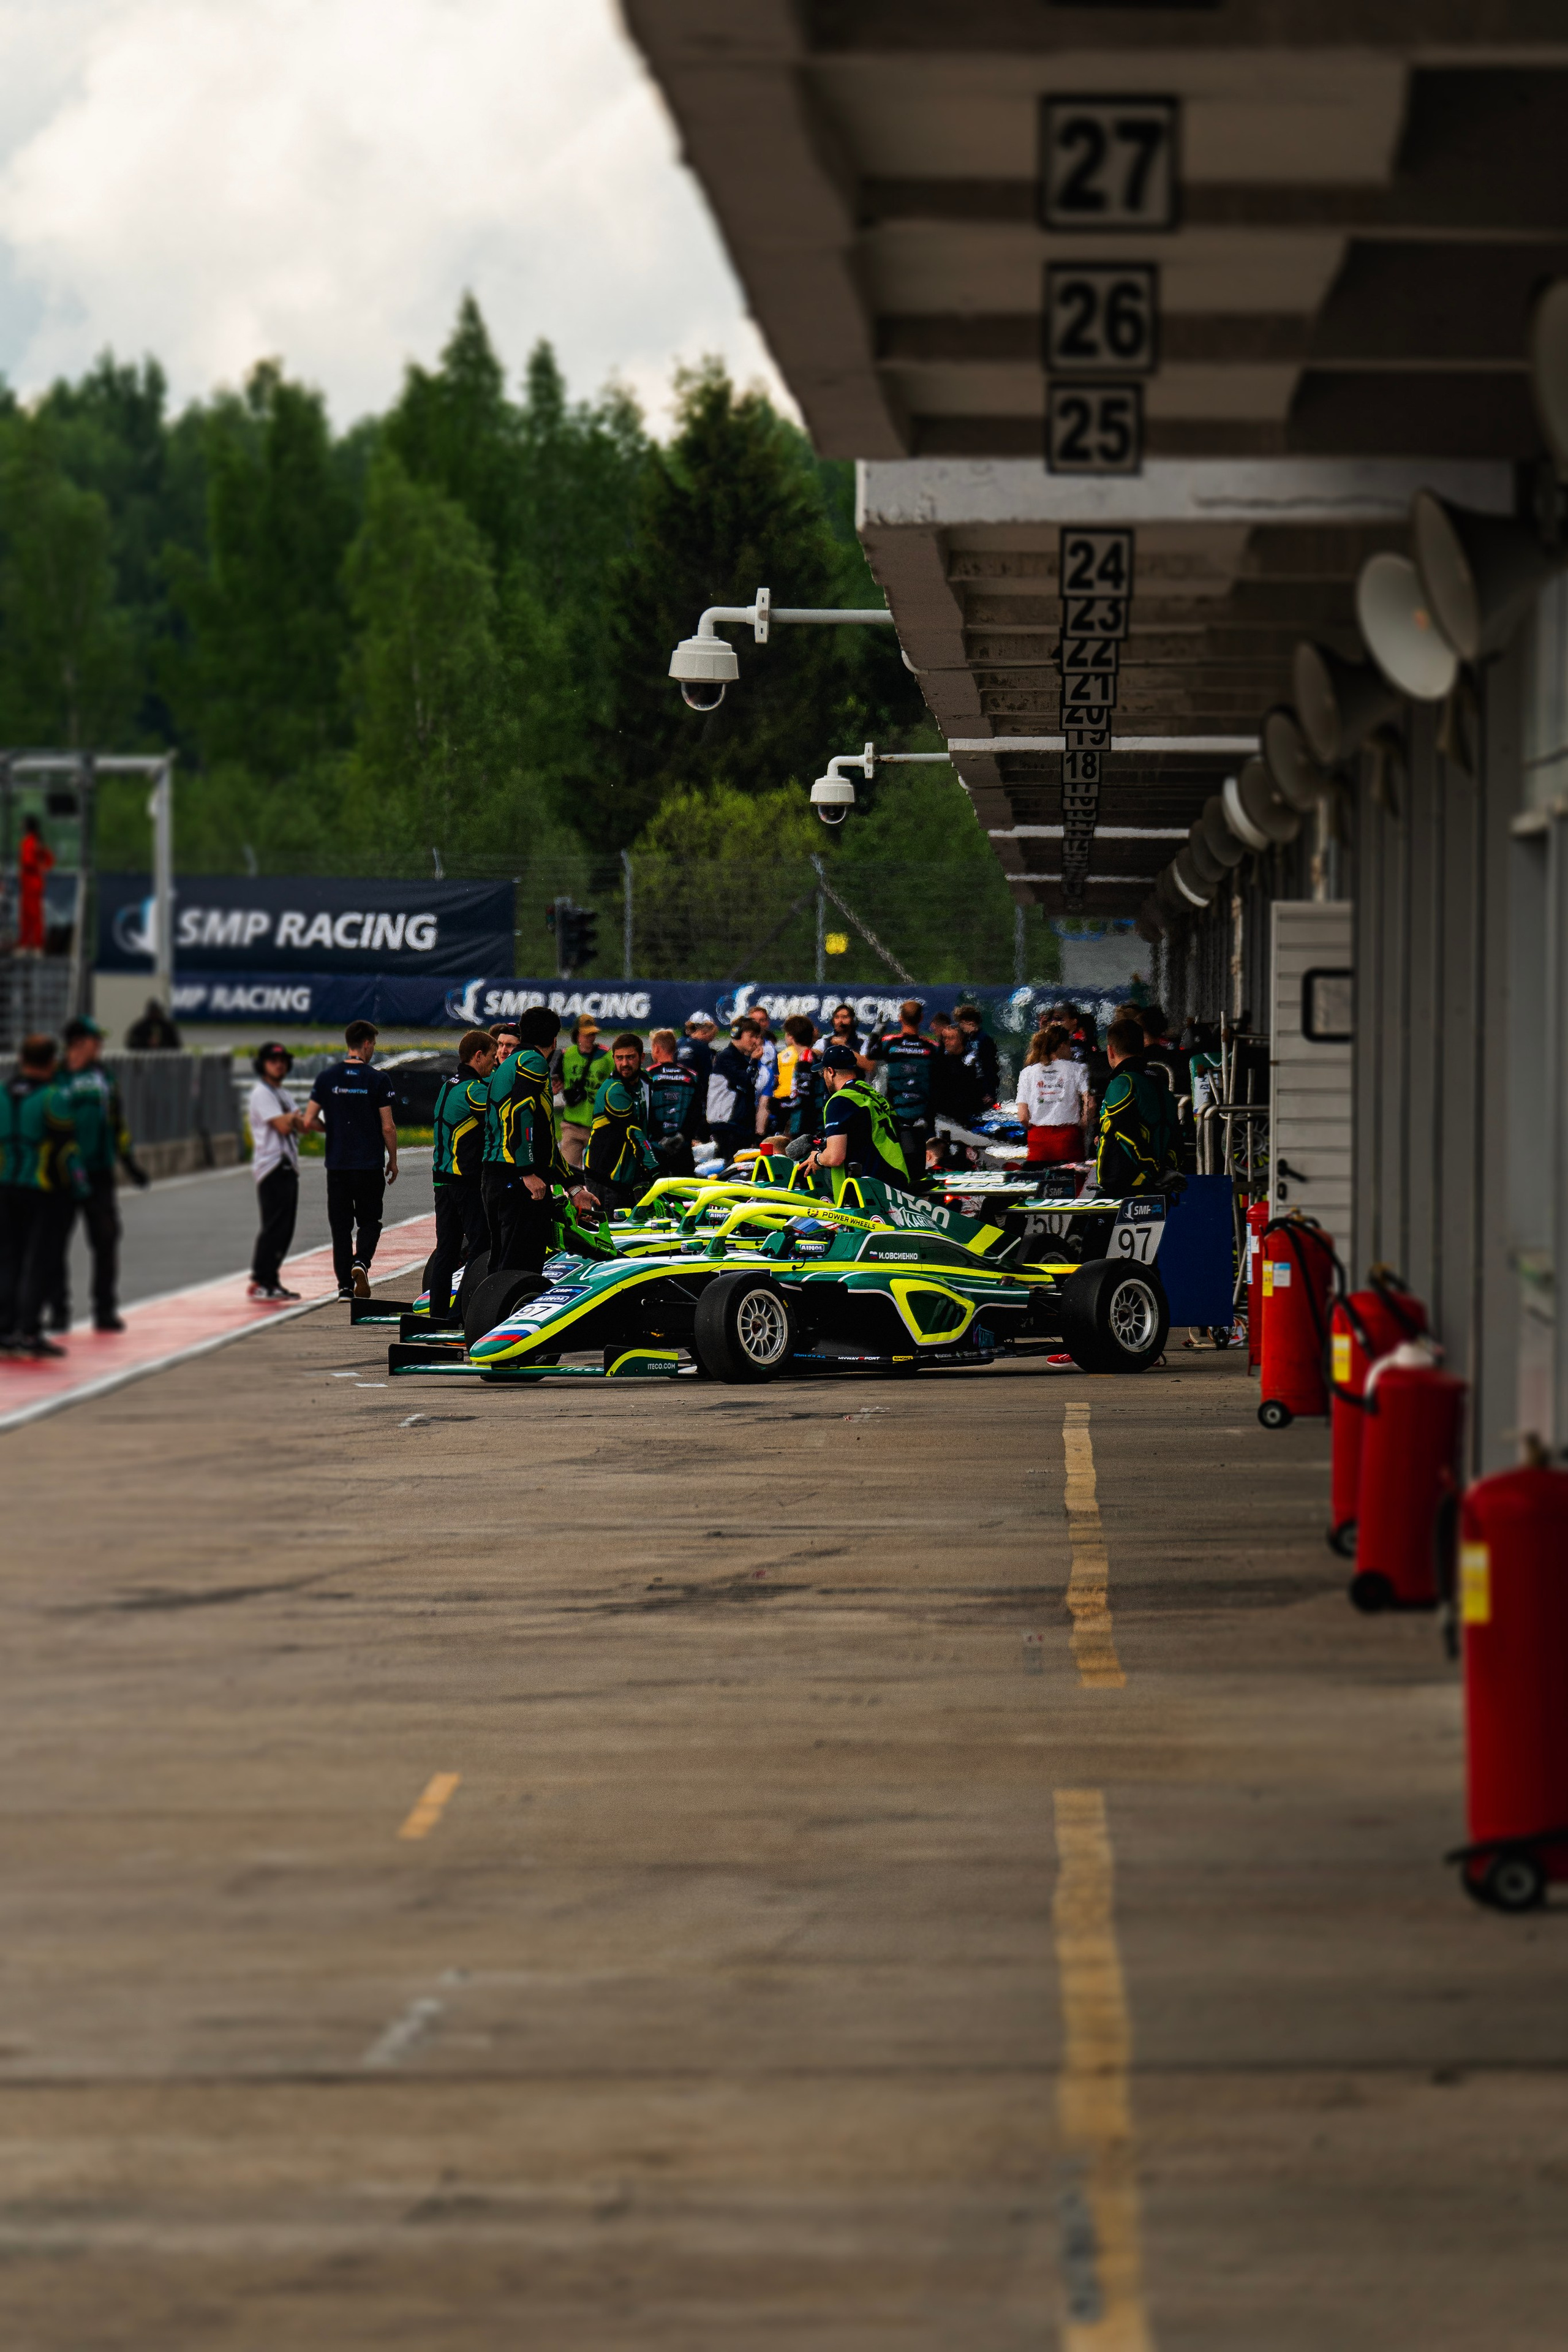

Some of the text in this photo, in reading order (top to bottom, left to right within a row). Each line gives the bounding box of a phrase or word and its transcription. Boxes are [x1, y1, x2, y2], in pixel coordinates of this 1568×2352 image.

[1056, 115, 1163, 213] 27
[1057, 279, 1147, 360] 26
[1057, 396, 1132, 462] 25
[1066, 540, 1125, 590] 24
[1069, 598, 1121, 631] 23
[1066, 641, 1113, 668] 22
[1069, 676, 1109, 700] 21
[1065, 752, 1097, 780] 18
[178, 910, 437, 951] SMP RACING
[172, 986, 312, 1012] MP RACING
[484, 989, 652, 1019] SMP RACING
[822, 1211, 850, 1222] POWER
[850, 1217, 876, 1230] WHEELS
[1118, 1227, 1152, 1261] 97
[514, 1306, 552, 1317] 97
